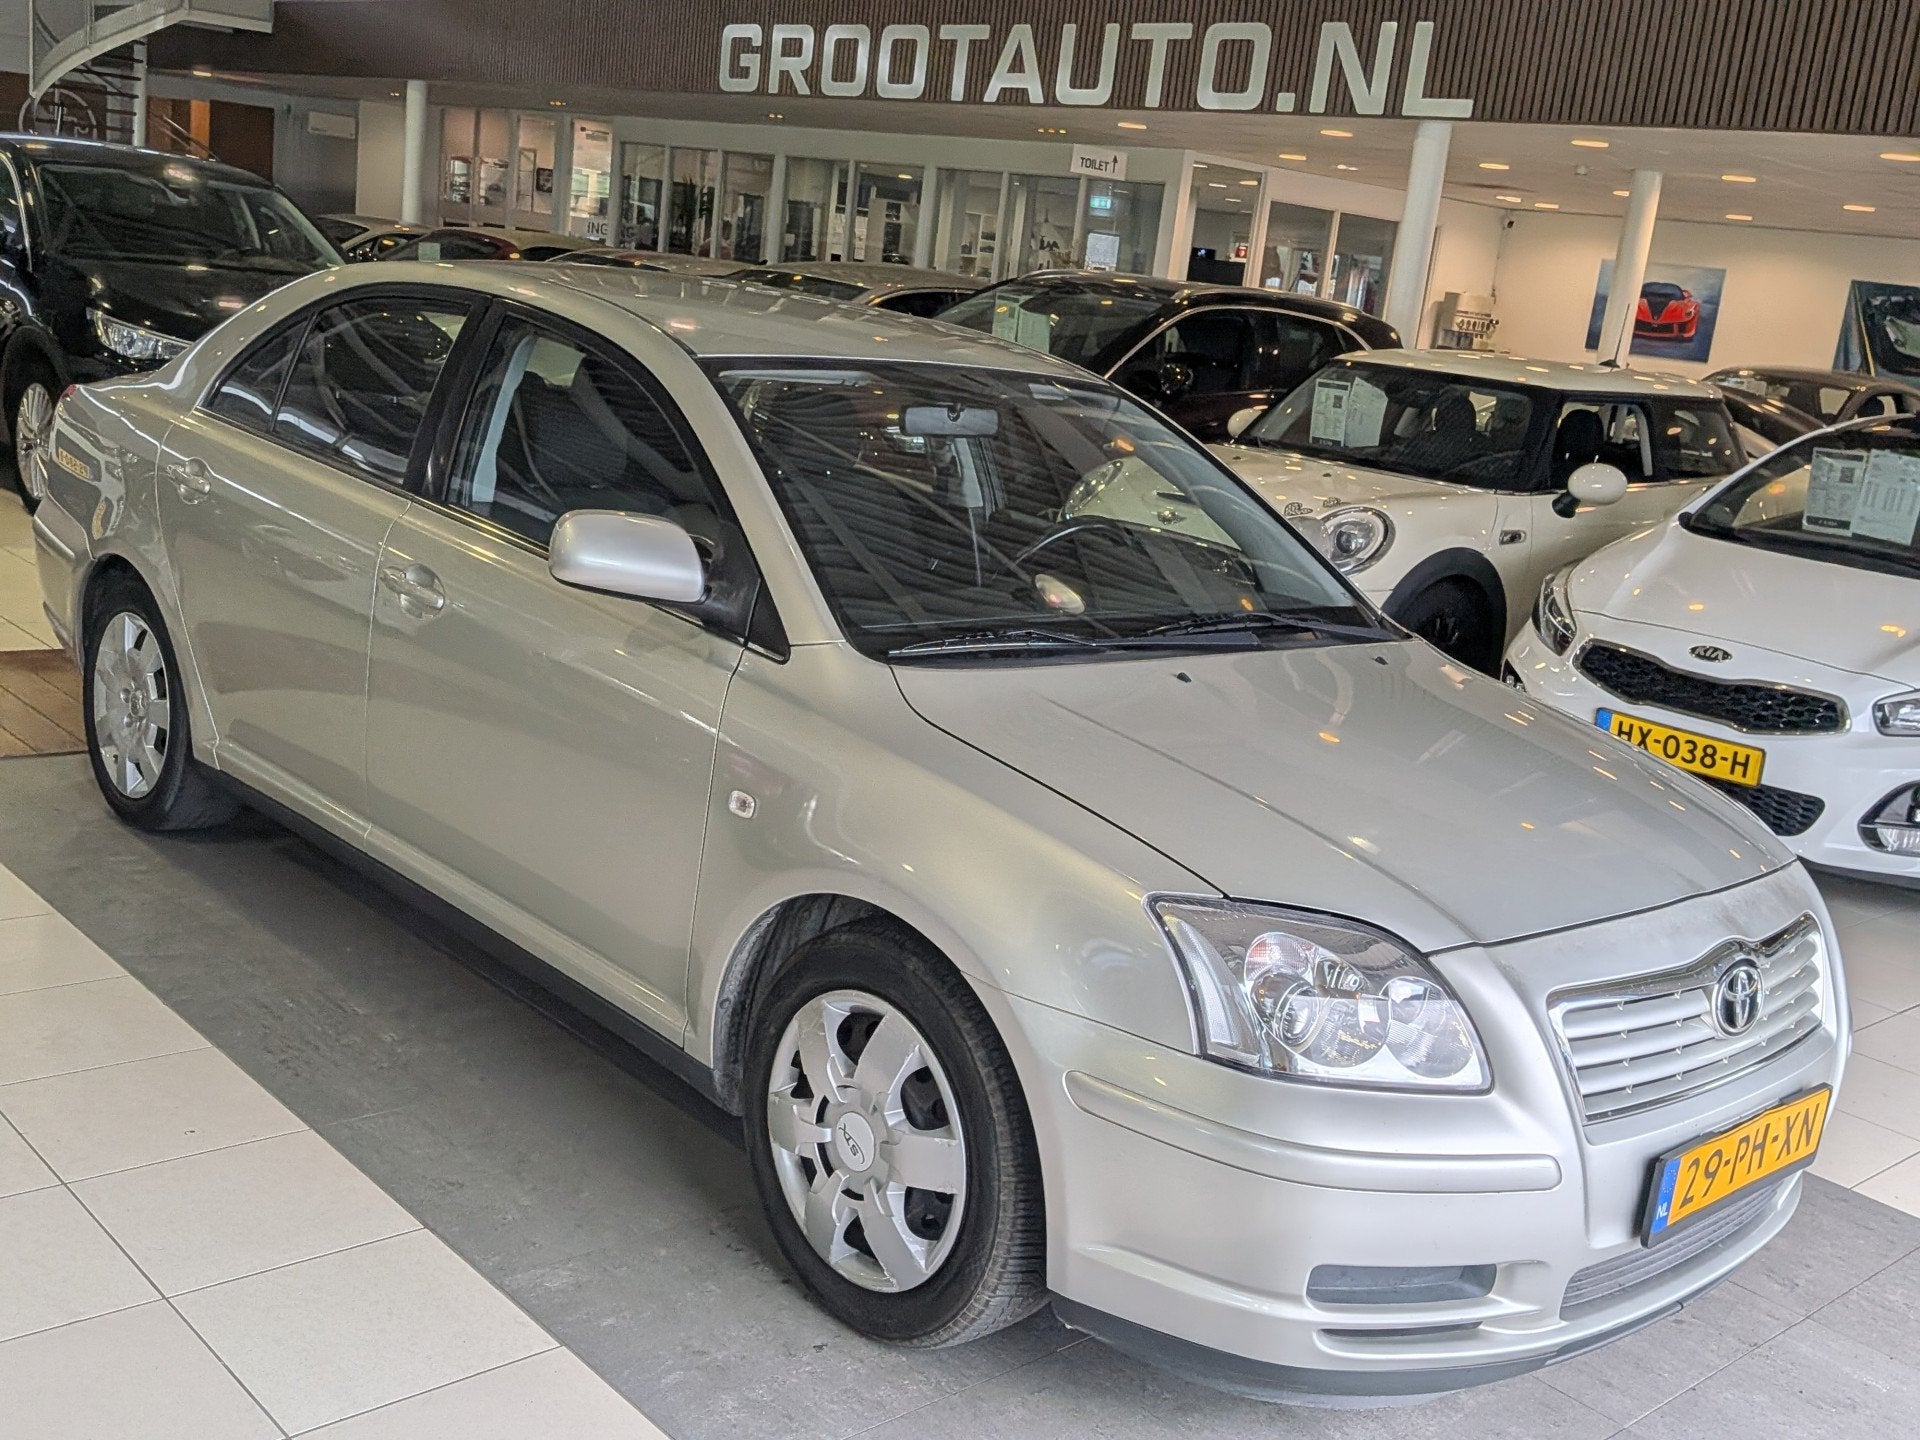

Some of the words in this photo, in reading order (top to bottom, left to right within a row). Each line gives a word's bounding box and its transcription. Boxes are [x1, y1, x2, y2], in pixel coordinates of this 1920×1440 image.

[718, 21, 1474, 118] GROOTAUTO.NL
[1080, 156, 1110, 172] TOILET
[1694, 646, 1724, 663] KIA
[1616, 720, 1751, 778] HX-038-H
[1678, 1102, 1820, 1210] 29-PH-XN
[1655, 1204, 1668, 1220] NL
